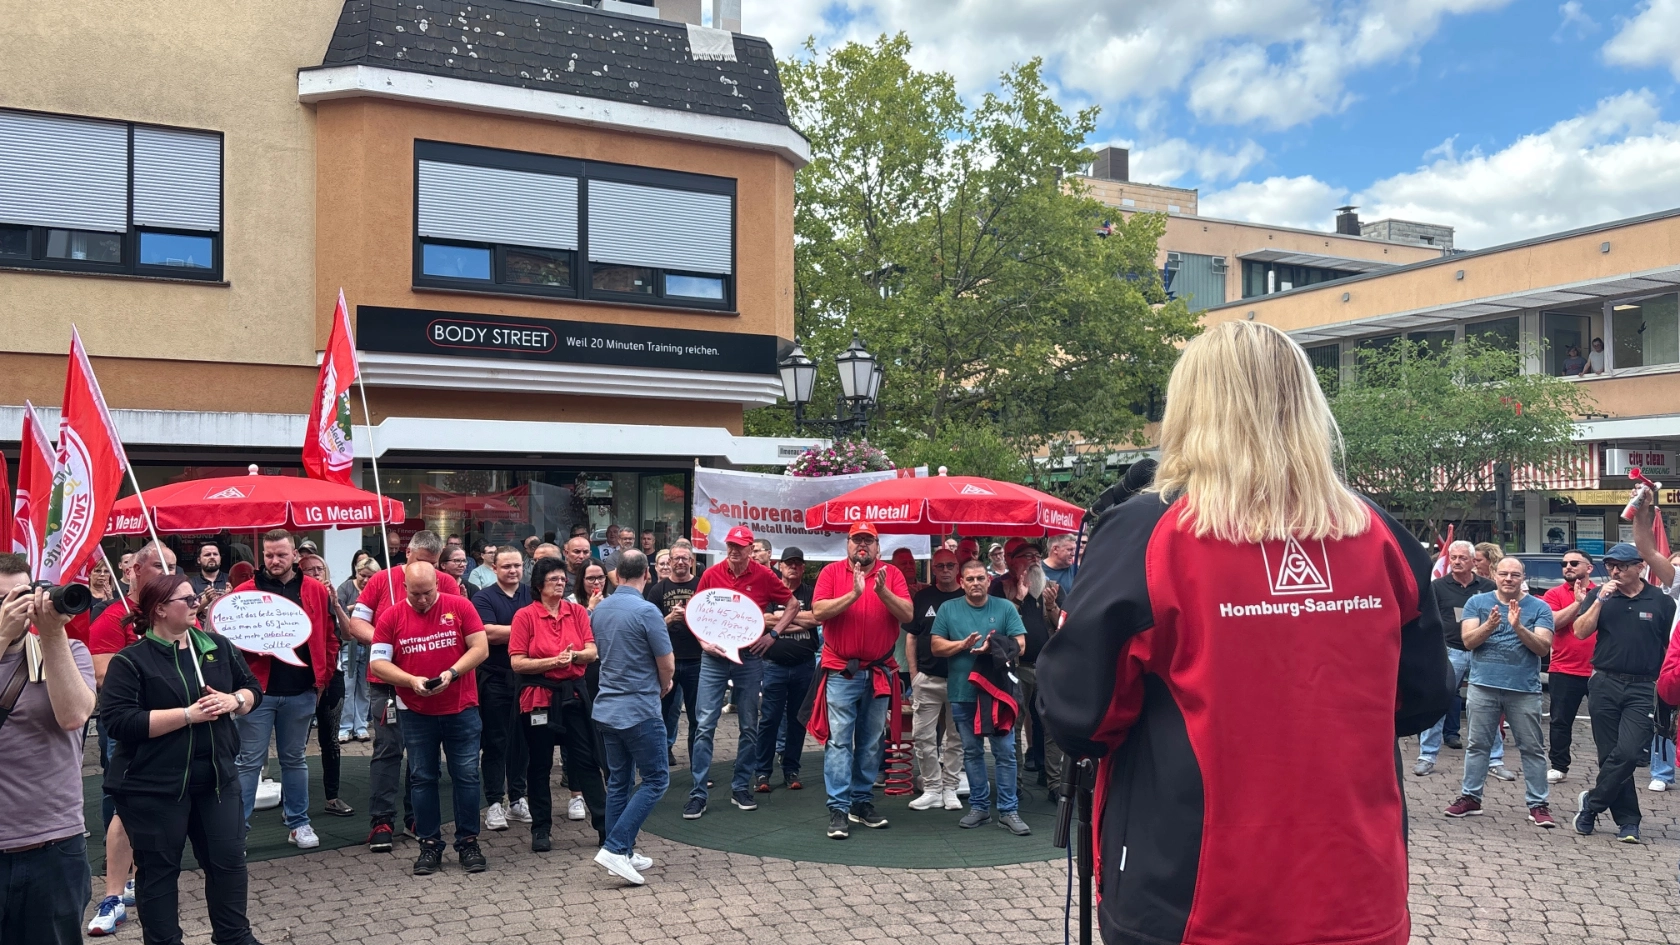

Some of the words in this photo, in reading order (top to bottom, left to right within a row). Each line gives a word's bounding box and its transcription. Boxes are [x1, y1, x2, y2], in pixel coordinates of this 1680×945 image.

[434, 325, 487, 343] BODY
[492, 328, 549, 347] STREET
[566, 336, 587, 348] Weil
[591, 338, 603, 348] 20
[606, 339, 644, 351] Minuten
[647, 341, 682, 355] Training
[685, 345, 720, 355] reichen.
[1628, 451, 1644, 467] city
[1646, 451, 1665, 466] clean
[1667, 489, 1680, 503] cit
[306, 506, 323, 522] IG
[327, 505, 373, 521] Metall
[708, 498, 805, 522] Seniorena
[843, 506, 861, 521] IG
[865, 505, 909, 521] Metall
[1042, 509, 1050, 523] IG
[1051, 511, 1073, 527] Metall
[752, 523, 783, 534] Metall
[695, 603, 714, 613] Nach
[717, 607, 732, 616] 45
[730, 610, 757, 623] Jahren
[1219, 595, 1383, 617] Homburg-Saarpfalz
[213, 613, 234, 622] Merz
[276, 620, 300, 629] Jahren
[696, 615, 718, 625] ohne
[721, 620, 750, 634] Abzug
[399, 629, 457, 645] Vertrauensleute
[702, 626, 712, 635] in
[402, 643, 426, 655] JOHN
[428, 637, 457, 651] DEERE
